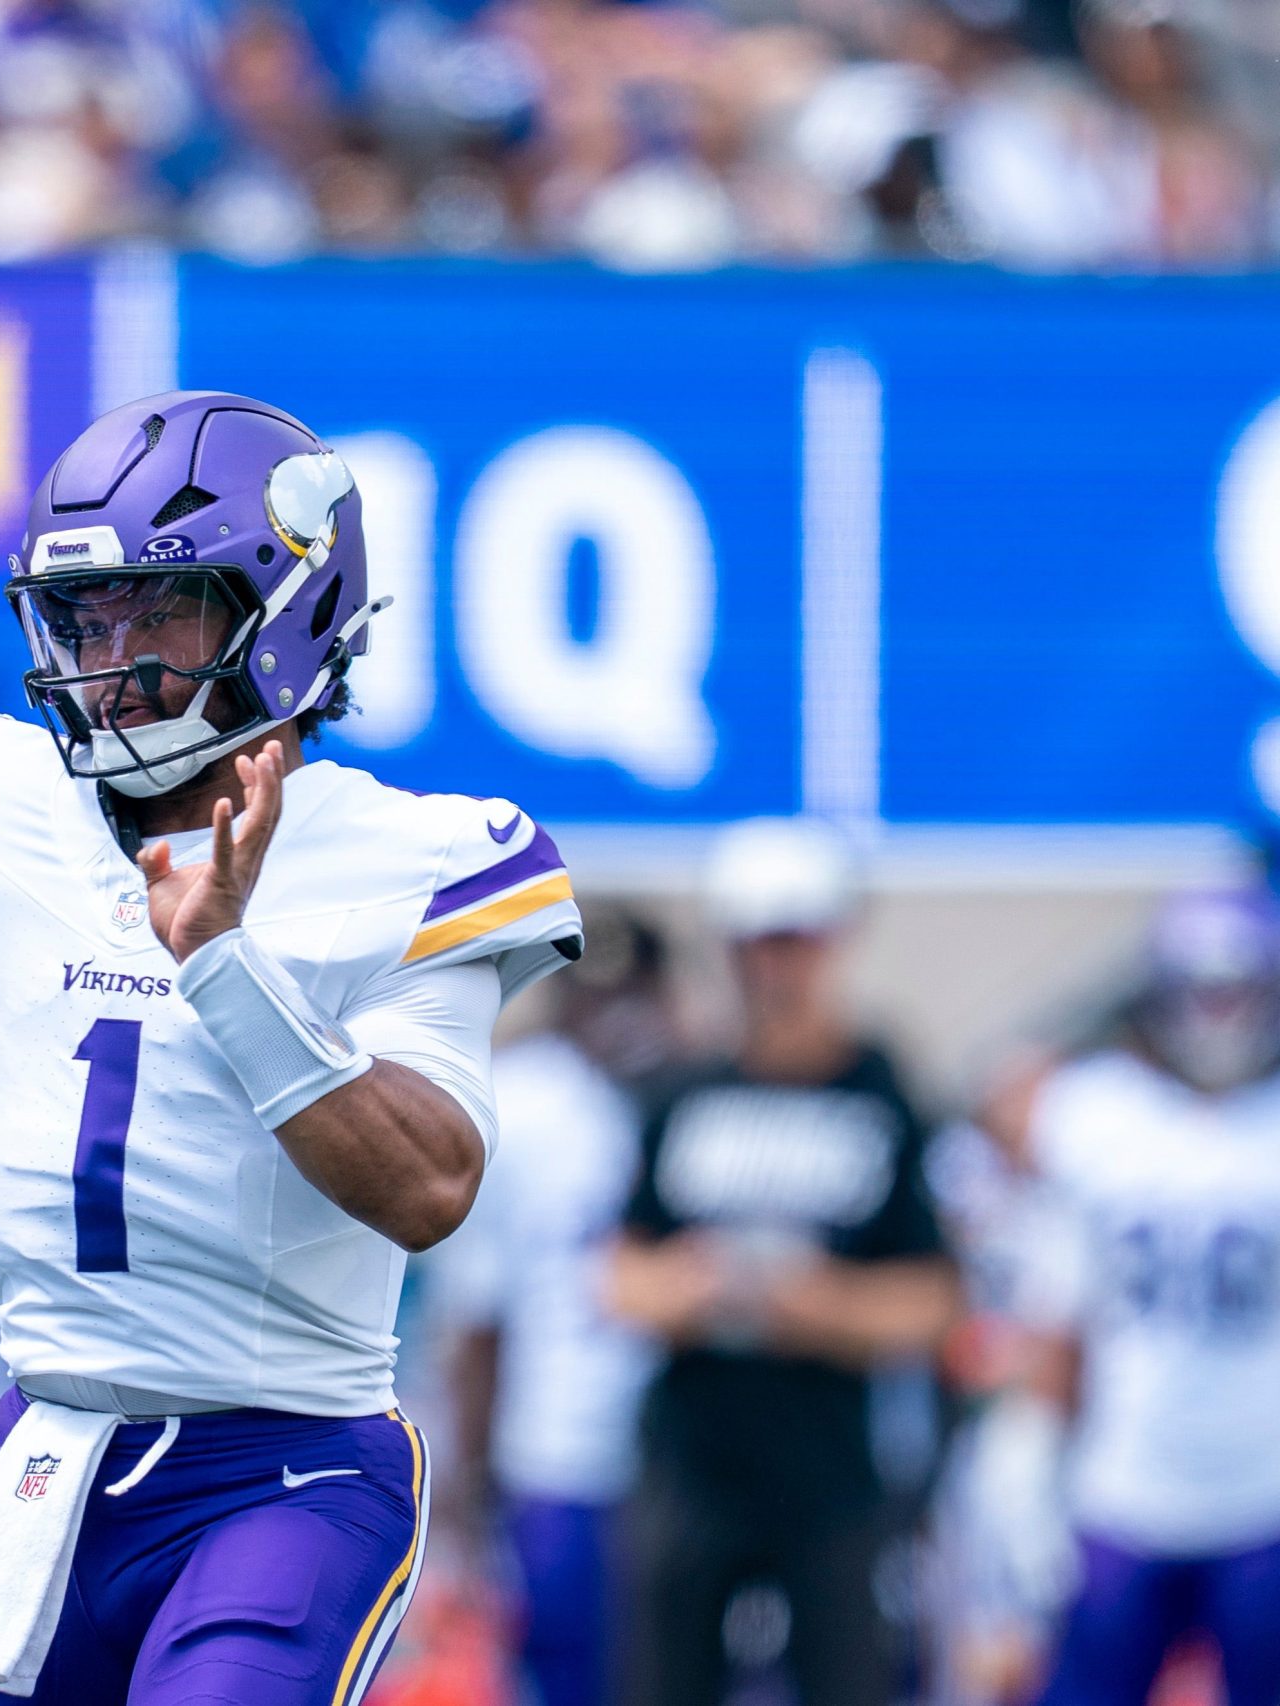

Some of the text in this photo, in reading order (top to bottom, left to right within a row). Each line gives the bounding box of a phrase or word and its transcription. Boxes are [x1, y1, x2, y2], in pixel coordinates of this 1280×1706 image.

[140, 548, 194, 563] OAKLEY
[115, 904, 138, 921] NFL
[63, 955, 172, 999] VIKINGS
[71, 1017, 143, 1273] 1
[19, 1475, 49, 1497] NFL
